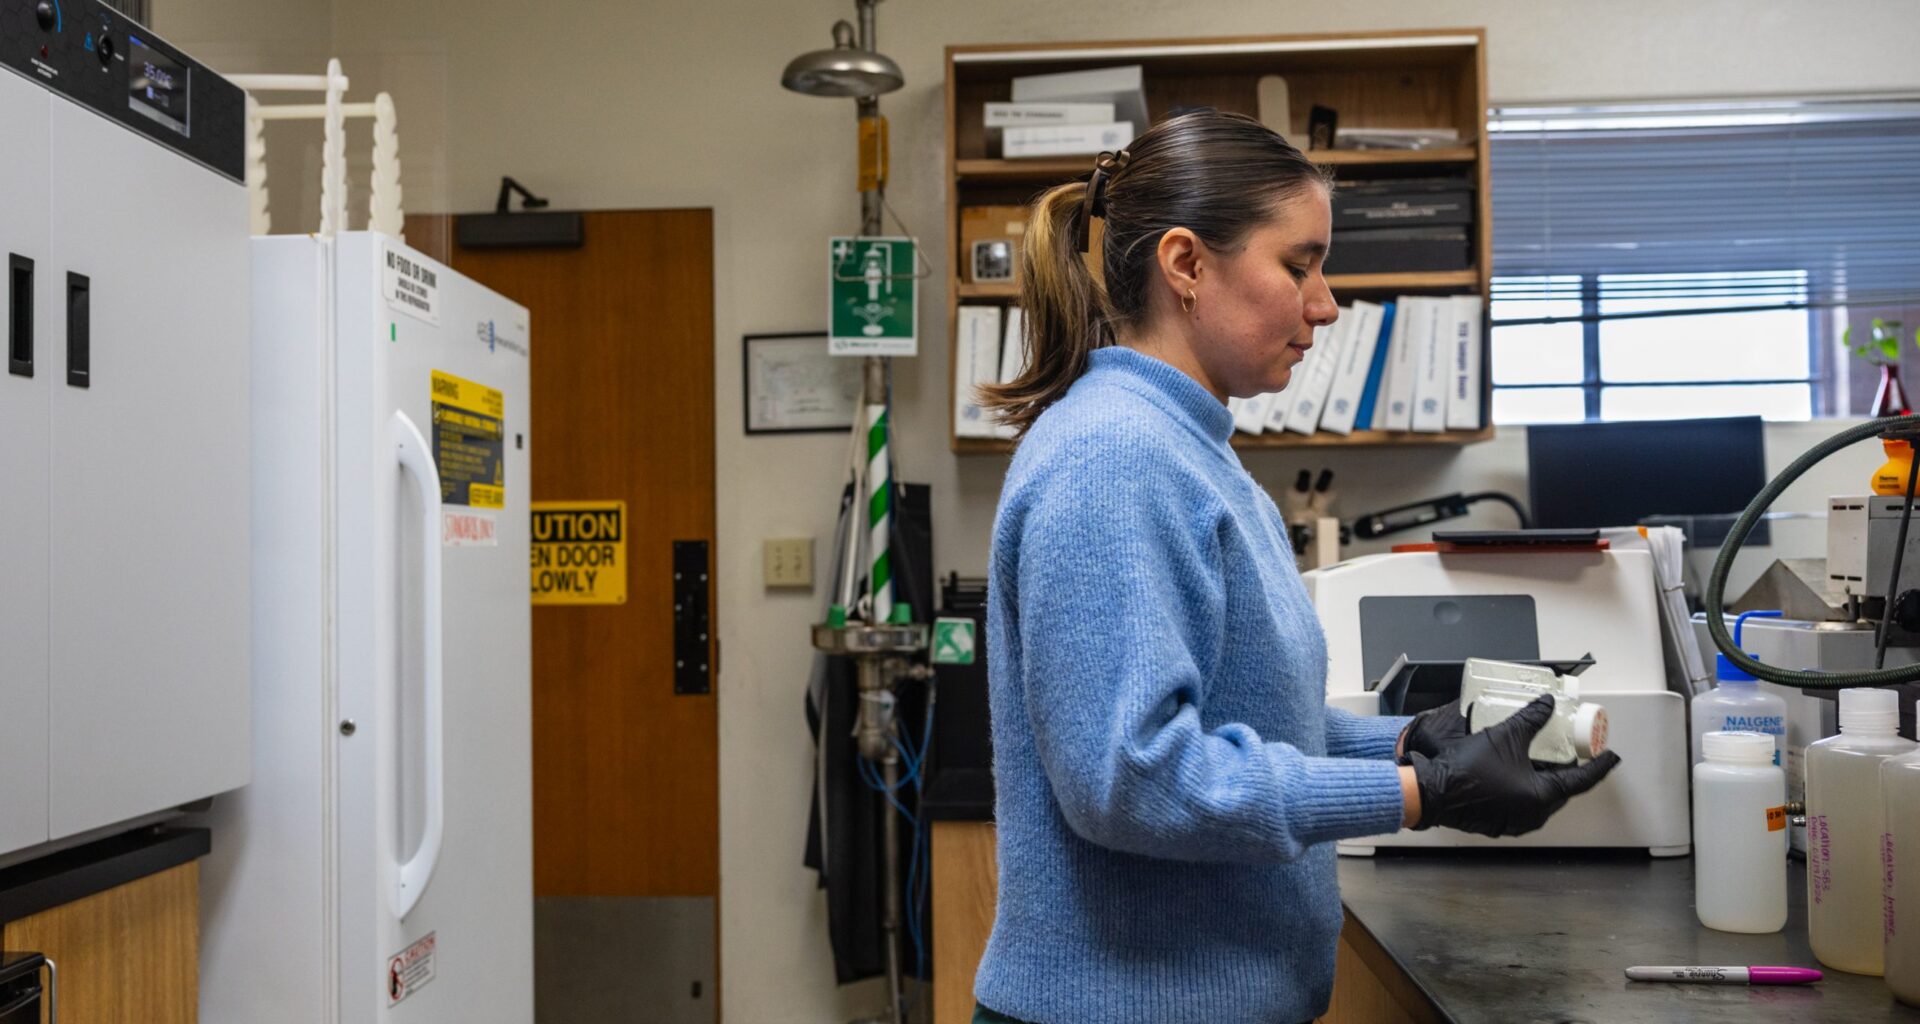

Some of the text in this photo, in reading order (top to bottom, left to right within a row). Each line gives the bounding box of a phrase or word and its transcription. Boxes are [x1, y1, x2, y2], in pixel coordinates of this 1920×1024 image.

[387, 250, 437, 289] NO FOOD OR DRINK
[532, 512, 618, 540] UTION
[558, 545, 615, 567] DOOR
[532, 570, 598, 592] OWLY
[1726, 715, 1782, 727] NALGENE
